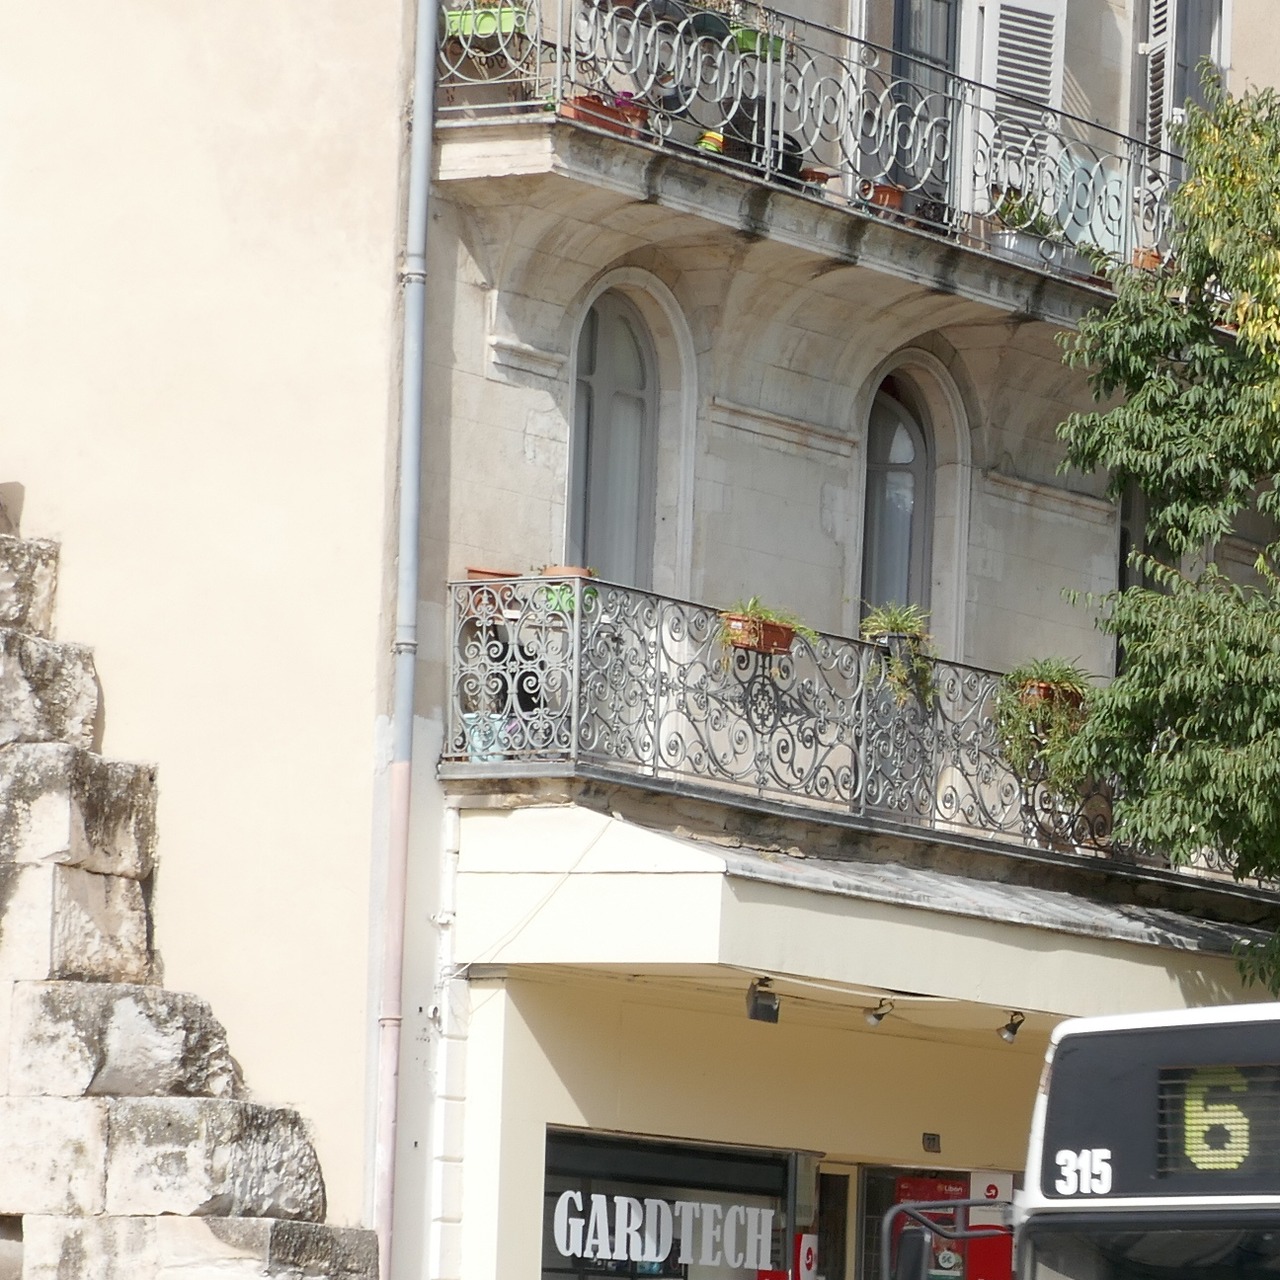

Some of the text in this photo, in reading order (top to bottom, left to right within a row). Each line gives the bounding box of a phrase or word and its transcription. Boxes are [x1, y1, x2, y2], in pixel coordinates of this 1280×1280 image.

[1184, 1066, 1250, 1170] 6
[1055, 1148, 1112, 1195] 315
[553, 1190, 775, 1271] GARDTECH
